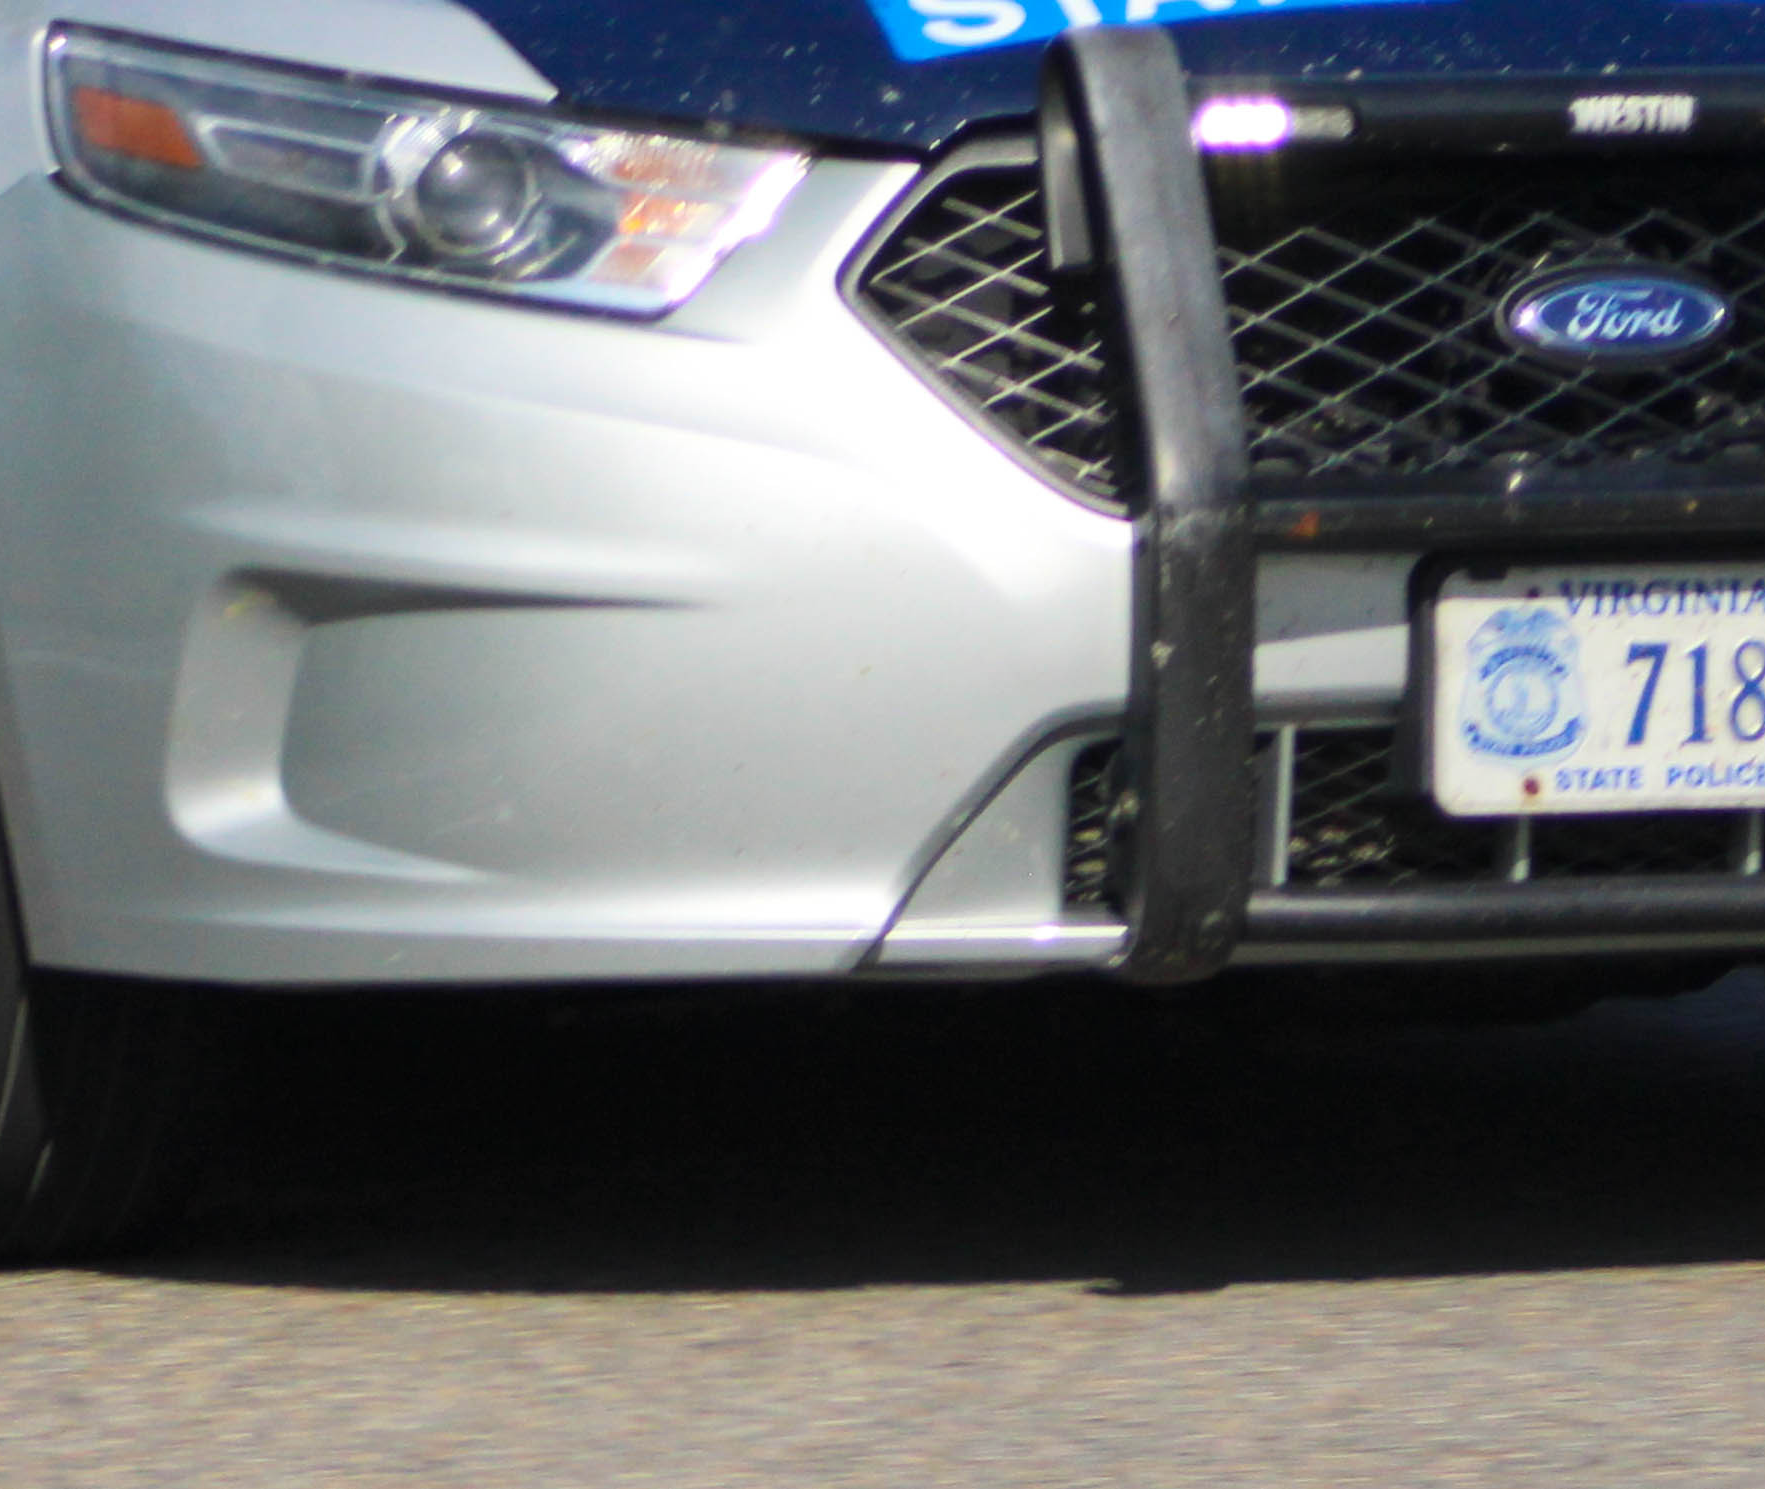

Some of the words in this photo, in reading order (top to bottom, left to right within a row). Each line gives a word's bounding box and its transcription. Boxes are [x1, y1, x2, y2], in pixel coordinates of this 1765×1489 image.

[1568, 94, 1697, 135] WESTIN
[1566, 287, 1684, 341] Ford
[1555, 765, 1644, 793] STATE
